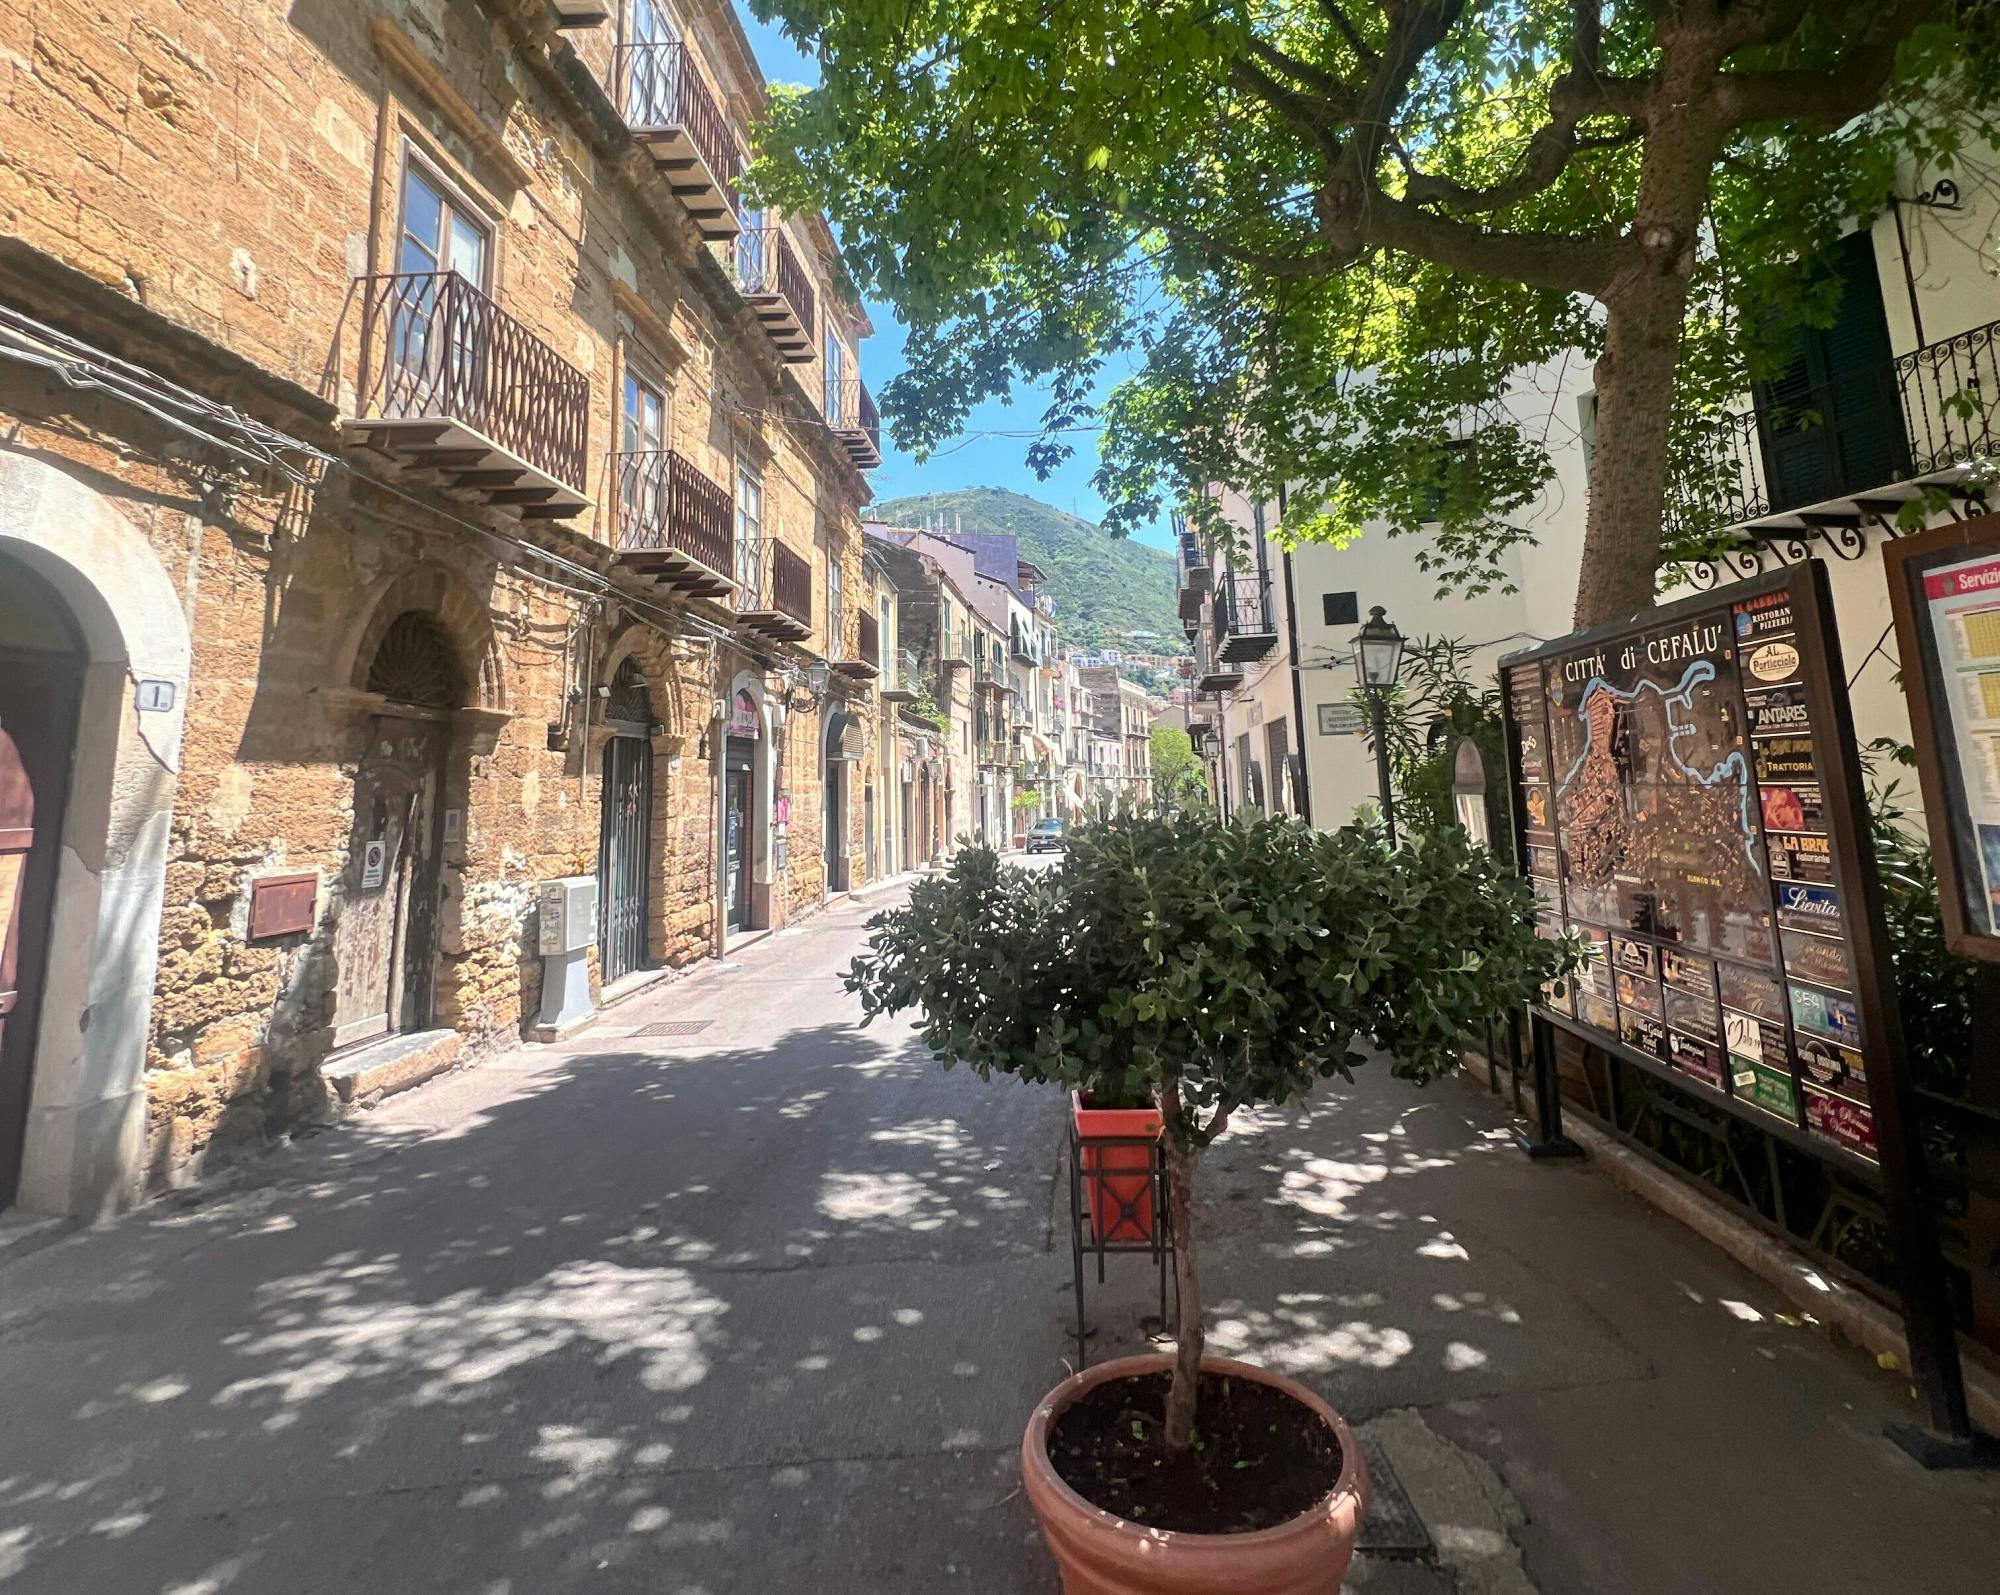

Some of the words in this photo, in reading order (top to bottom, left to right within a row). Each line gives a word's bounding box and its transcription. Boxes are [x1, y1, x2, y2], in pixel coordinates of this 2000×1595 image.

[1566, 654, 1606, 682] CITTA'
[1621, 646, 1636, 670] di
[1647, 624, 1722, 664] CEFALU'
[1765, 645, 1779, 657] AL
[1753, 656, 1796, 672] Porticciolo
[1759, 704, 1808, 725] ANTARES
[1767, 761, 1814, 772] TRATTORIA
[1782, 836, 1799, 851] LA
